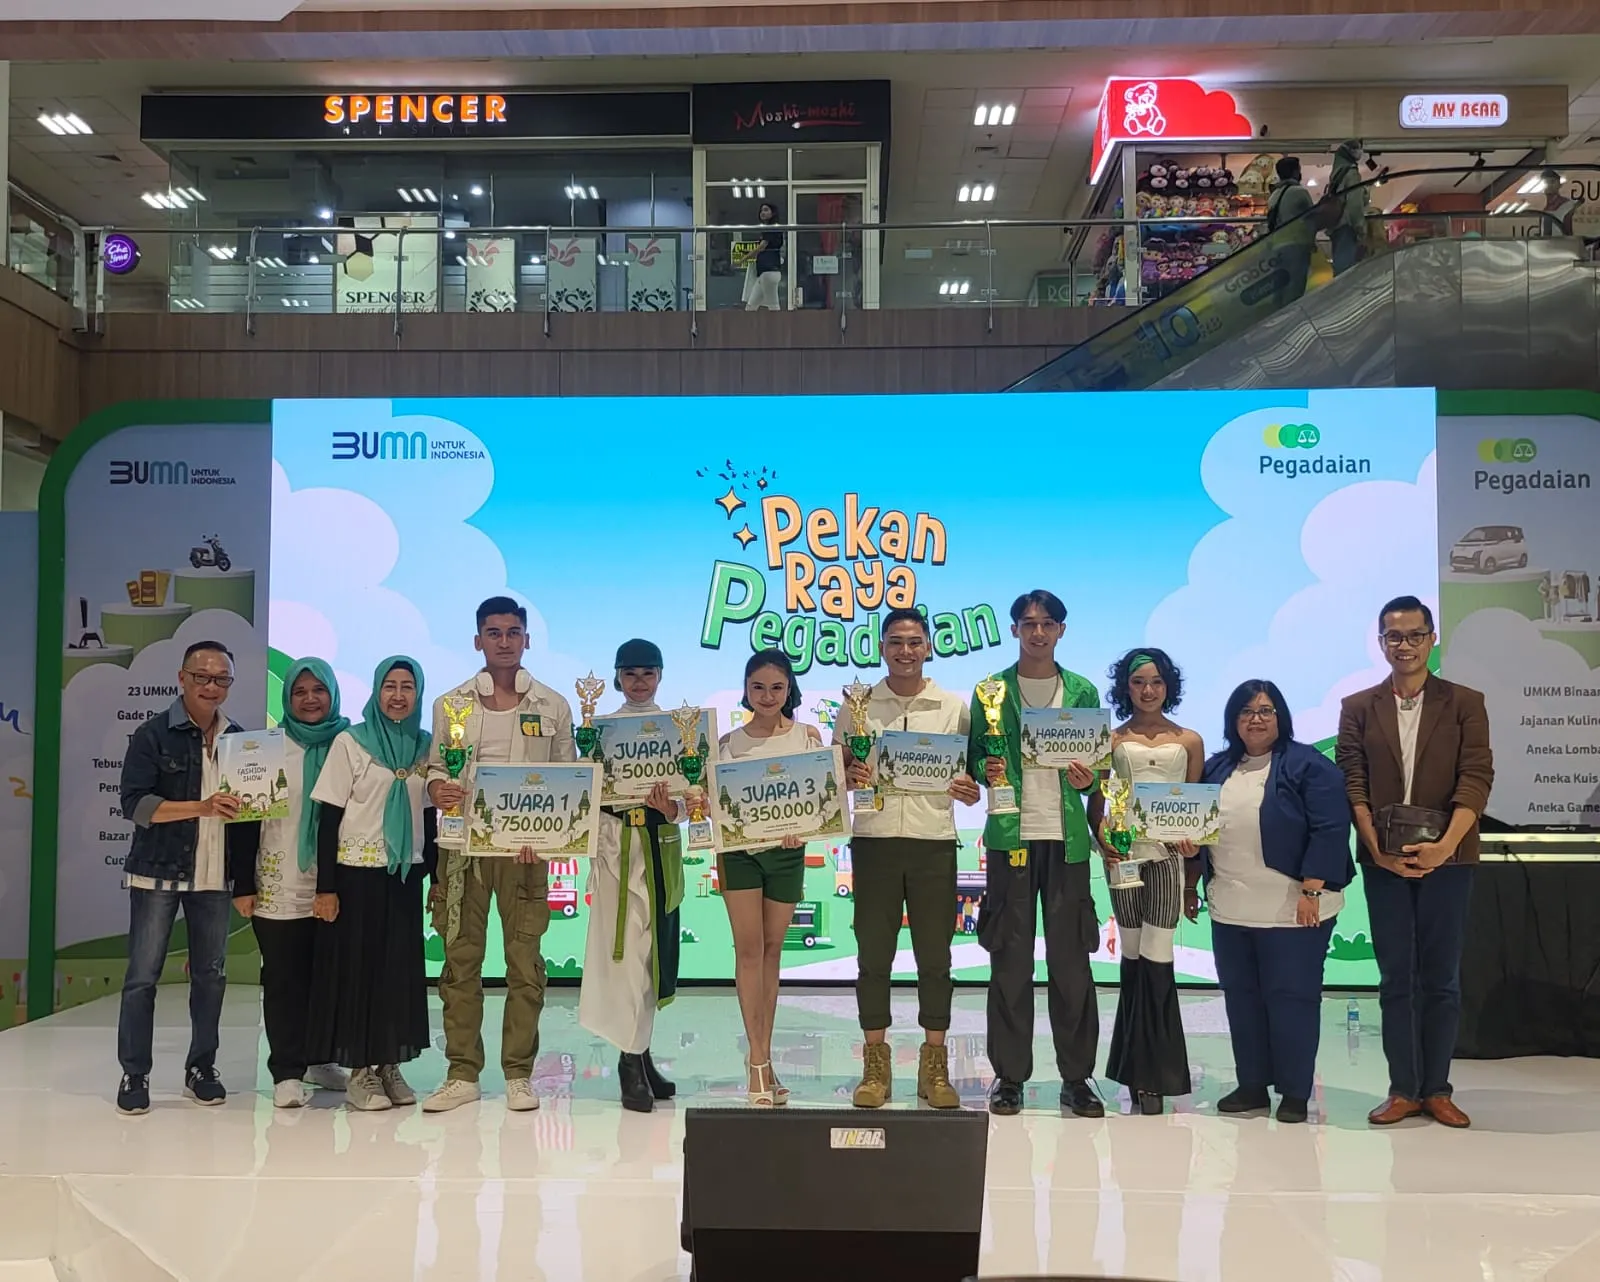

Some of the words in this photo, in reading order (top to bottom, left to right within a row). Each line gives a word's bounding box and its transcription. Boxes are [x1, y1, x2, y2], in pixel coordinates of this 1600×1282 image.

[324, 95, 507, 123] SPENCER
[1432, 102, 1456, 117] MY
[1461, 102, 1500, 117] BEAR
[431, 440, 466, 449] UNTUK
[431, 450, 486, 460] INDONESIA
[191, 468, 221, 477] UNTUK
[1260, 454, 1371, 479] Pegadaian
[191, 477, 237, 486] INDONESIA
[1474, 470, 1591, 495] Pegadaian
[761, 492, 947, 570] Pekan
[785, 551, 917, 622] Raya
[700, 559, 1002, 676] Pegadan
[127, 686, 141, 697] 23
[143, 686, 178, 697] UMKM
[1523, 686, 1562, 697] UMKM
[117, 709, 145, 721] Gade
[1520, 715, 1565, 728] Jajanan
[1035, 728, 1085, 740] HARAPAN
[1088, 728, 1095, 739] 3
[614, 740, 672, 760] JUARA
[1044, 741, 1092, 754] 200.000
[1526, 744, 1563, 755] Aneka
[92, 758, 123, 769] Tebus
[894, 750, 942, 765] HARAPAN
[945, 754, 952, 765] 2
[902, 764, 948, 779] 200.000
[1534, 773, 1571, 784] Aneka
[1573, 773, 1599, 784] Kuis
[741, 780, 800, 804] JUARA
[804, 778, 816, 795] 3
[496, 792, 555, 813] JUARA
[561, 793, 569, 811] 1
[1151, 801, 1200, 814] FAVORIT
[1528, 802, 1565, 813] Aneka
[750, 800, 814, 823] 350.000
[501, 815, 563, 832] 750.000
[1154, 815, 1199, 828] 150.000
[99, 831, 131, 841] Bazar
